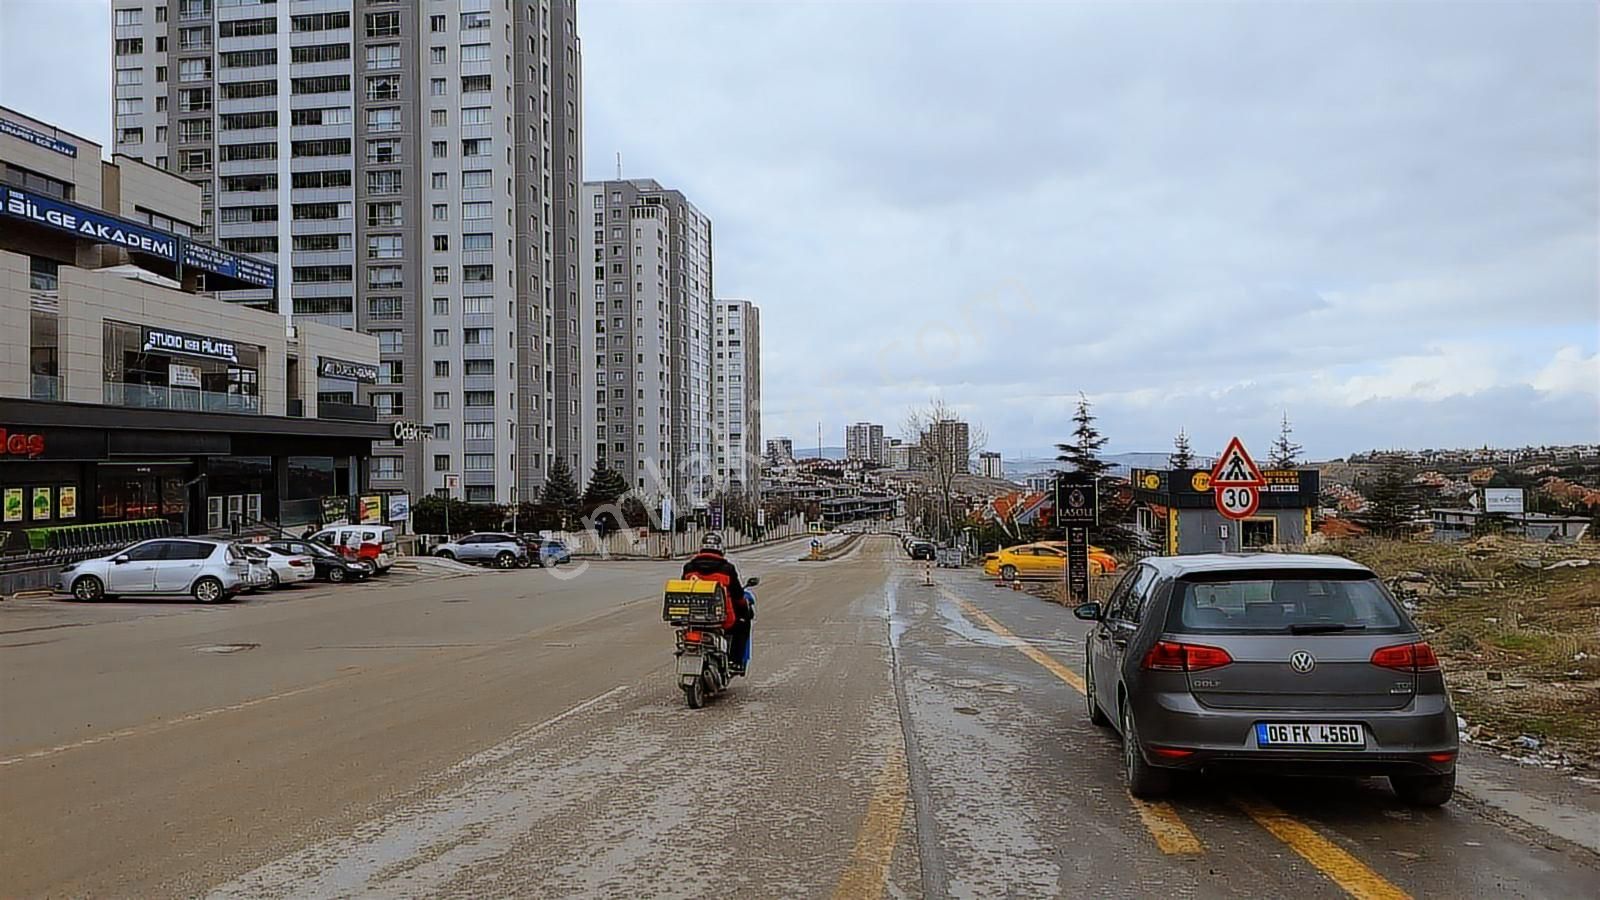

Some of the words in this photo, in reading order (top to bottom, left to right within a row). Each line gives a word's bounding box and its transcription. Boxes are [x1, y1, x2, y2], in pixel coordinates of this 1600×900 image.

[8, 199, 76, 229] BİLGE
[80, 220, 173, 257] AKADEMİ
[149, 332, 182, 348] STUDIO
[1225, 488, 1250, 508] 30
[1269, 725, 1288, 742] 06
[1292, 725, 1312, 742] FK
[1320, 725, 1359, 742] 4560
